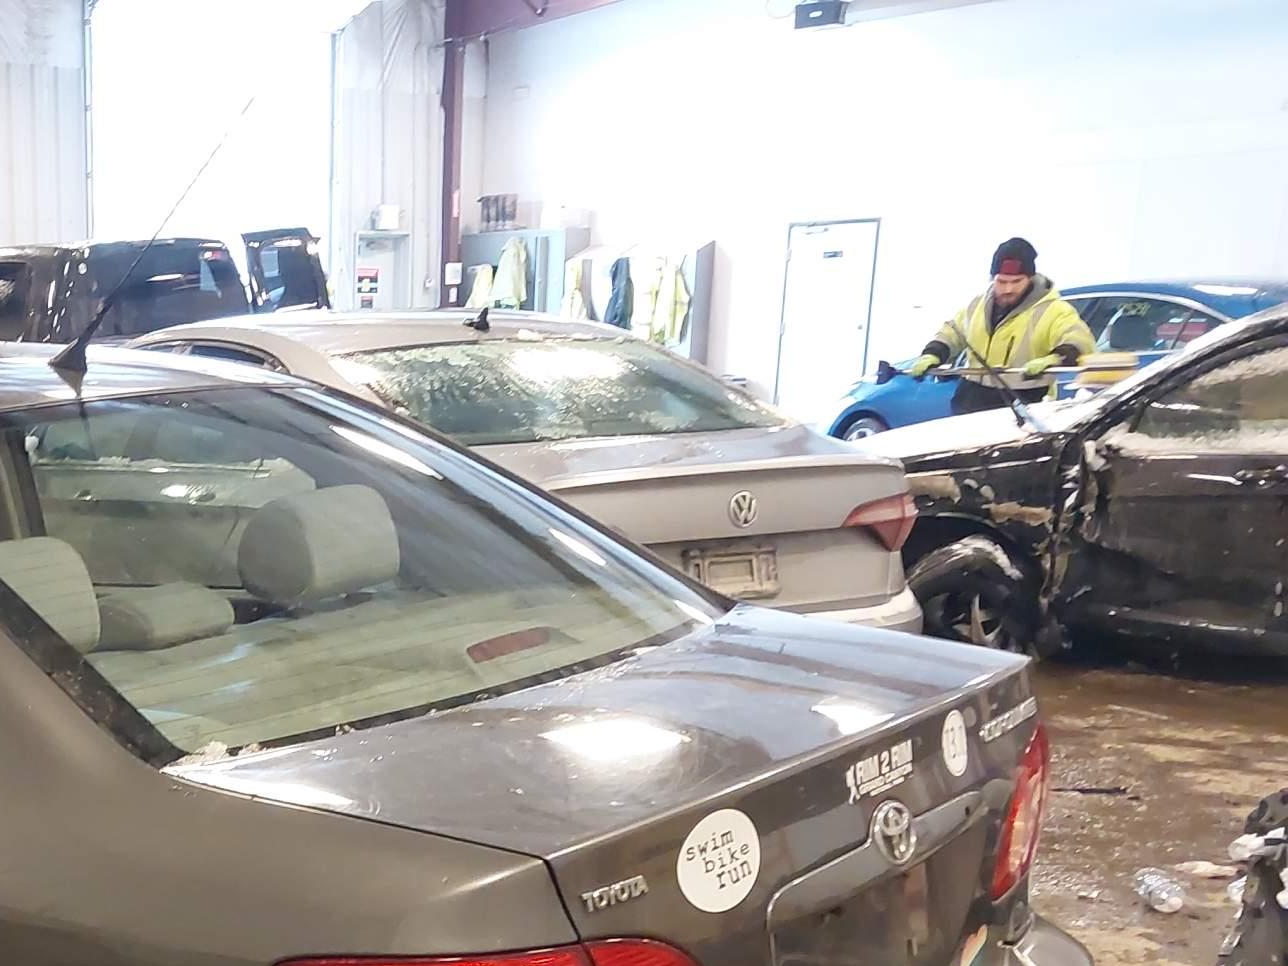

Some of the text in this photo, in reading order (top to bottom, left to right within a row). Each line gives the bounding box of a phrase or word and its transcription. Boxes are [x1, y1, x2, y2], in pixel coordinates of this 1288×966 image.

[880, 750, 890, 774] 2
[686, 830, 734, 862] swim
[702, 843, 750, 873] bike
[716, 860, 752, 890] run
[581, 874, 649, 913] TOYOTA
